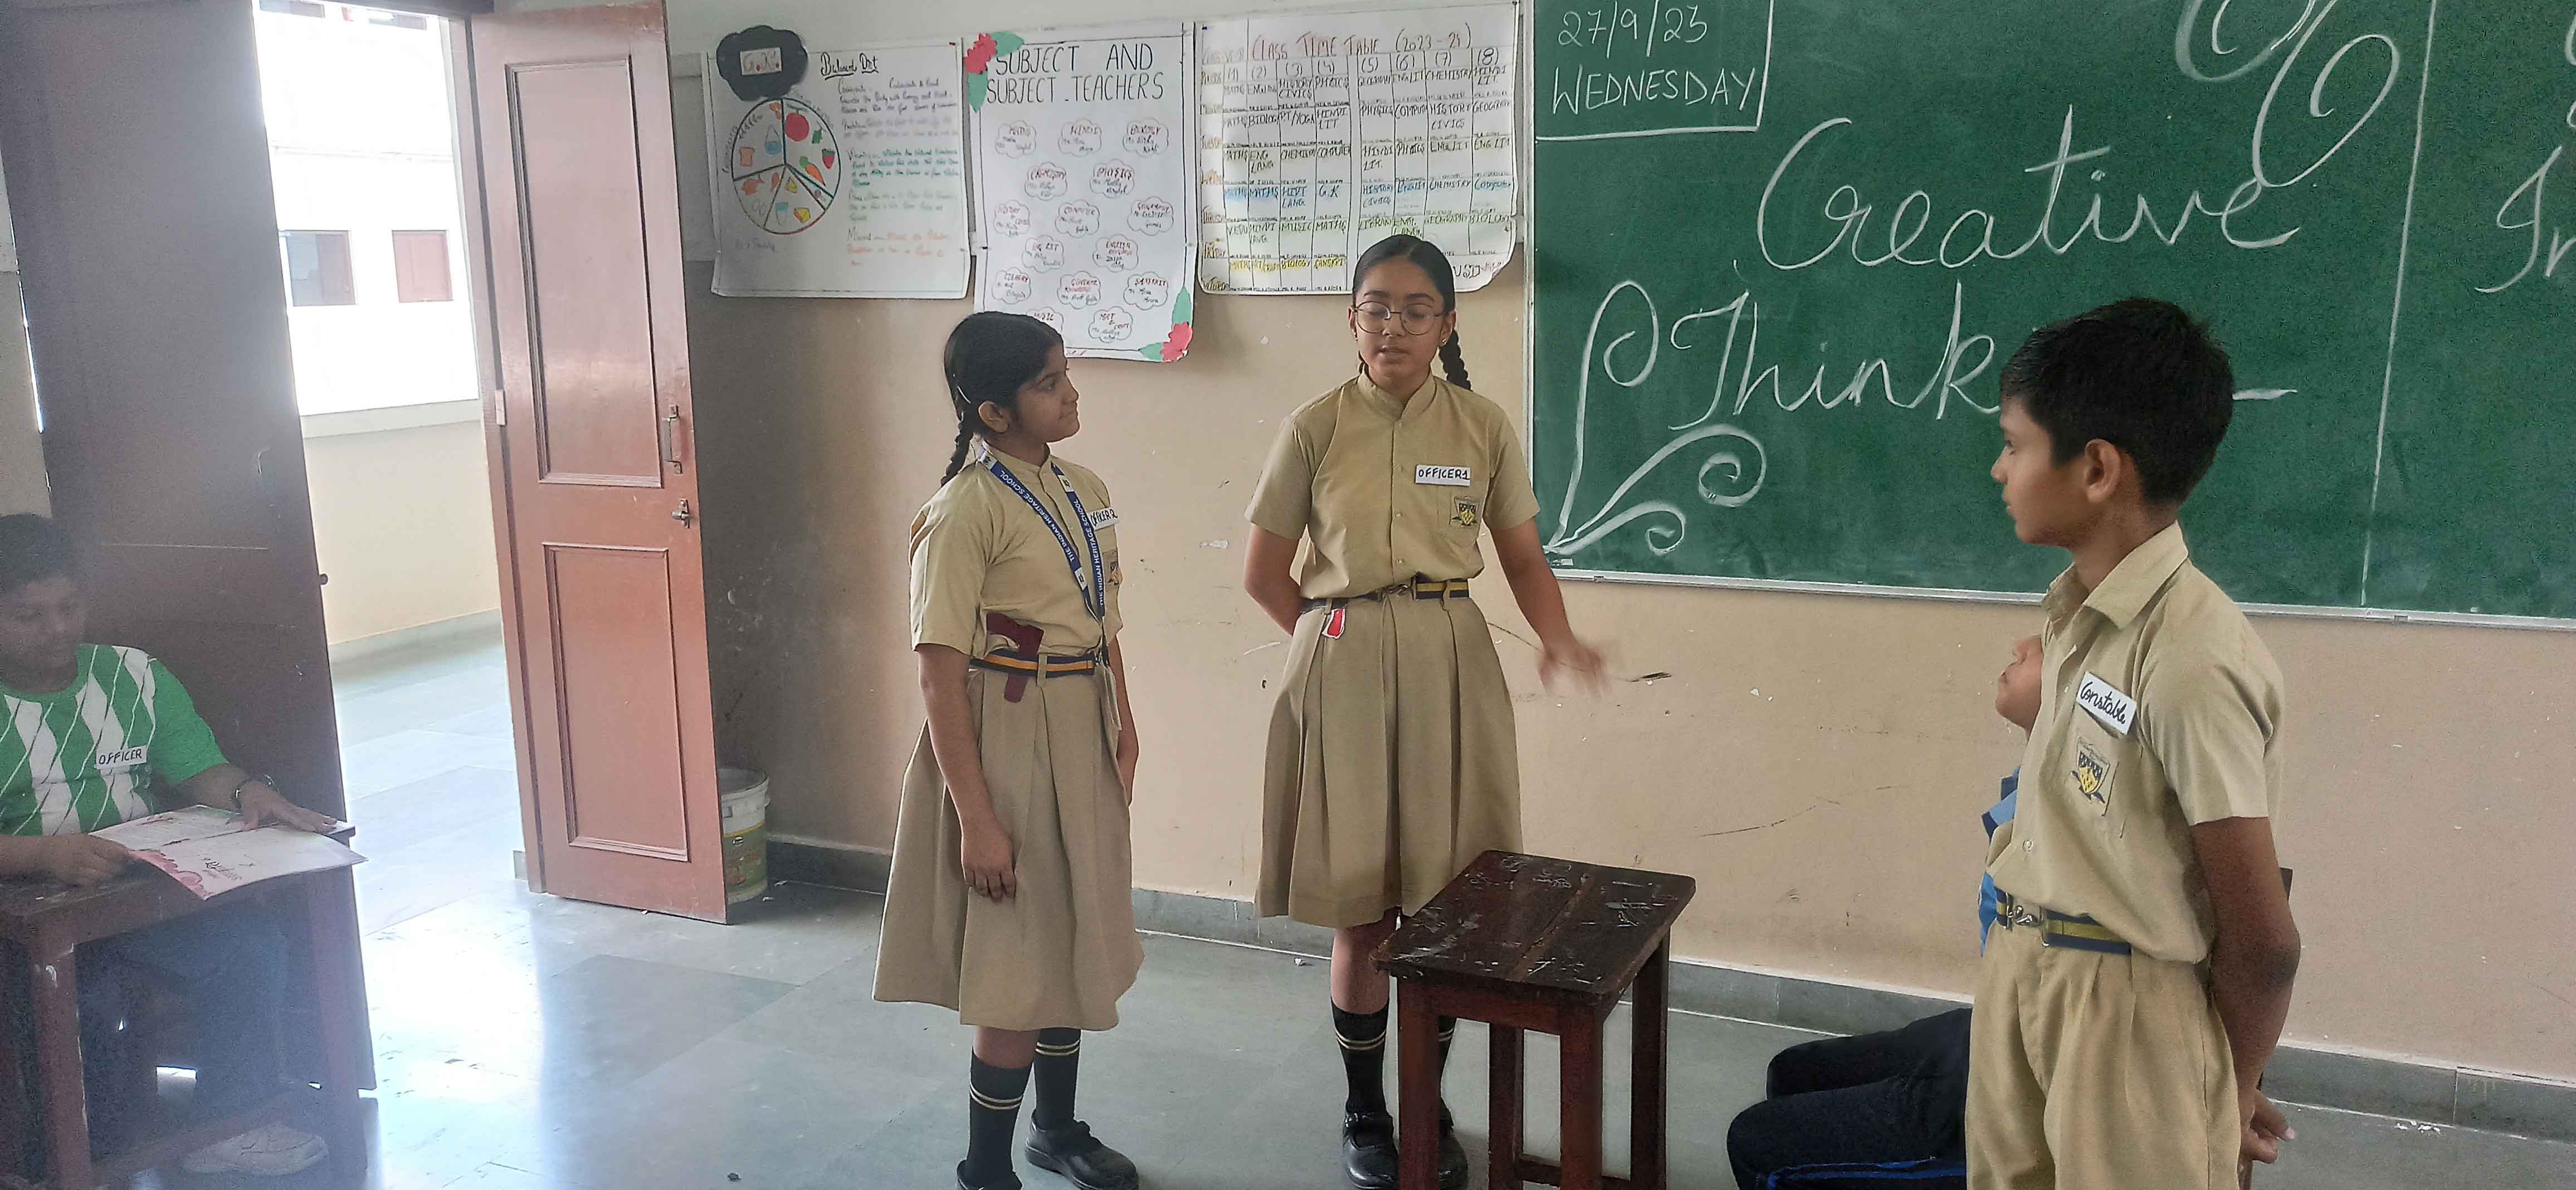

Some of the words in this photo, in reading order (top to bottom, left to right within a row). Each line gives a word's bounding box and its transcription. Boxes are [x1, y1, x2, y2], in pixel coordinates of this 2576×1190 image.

[996, 46, 1080, 75] SUBJECT
[1106, 43, 1153, 71] AND
[1362, 57, 1378, 73] (5)
[1396, 54, 1414, 71] (6)
[1436, 52, 1451, 66] (7)
[1477, 47, 1499, 66] (8)
[1252, 65, 1266, 82] (2)
[1286, 62, 1302, 76] (3)
[987, 77, 1057, 104] SUBJECT
[1552, 63, 1756, 115] WEDNESDAY
[1429, 179, 1471, 191] CHEMISTRY
[1757, 104, 2301, 270] Creative
[1315, 221, 1347, 235] MATHS
[999, 470, 1026, 495] SCHOOL
[1024, 493, 1052, 525] HERITAGE
[1074, 499, 1090, 527] SCHOOL
[1051, 523, 1067, 548] INDIAN
[1065, 546, 1075, 562] THE
[1085, 527, 1099, 564] HERITAGE
[99, 748, 142, 765] OFFICER
